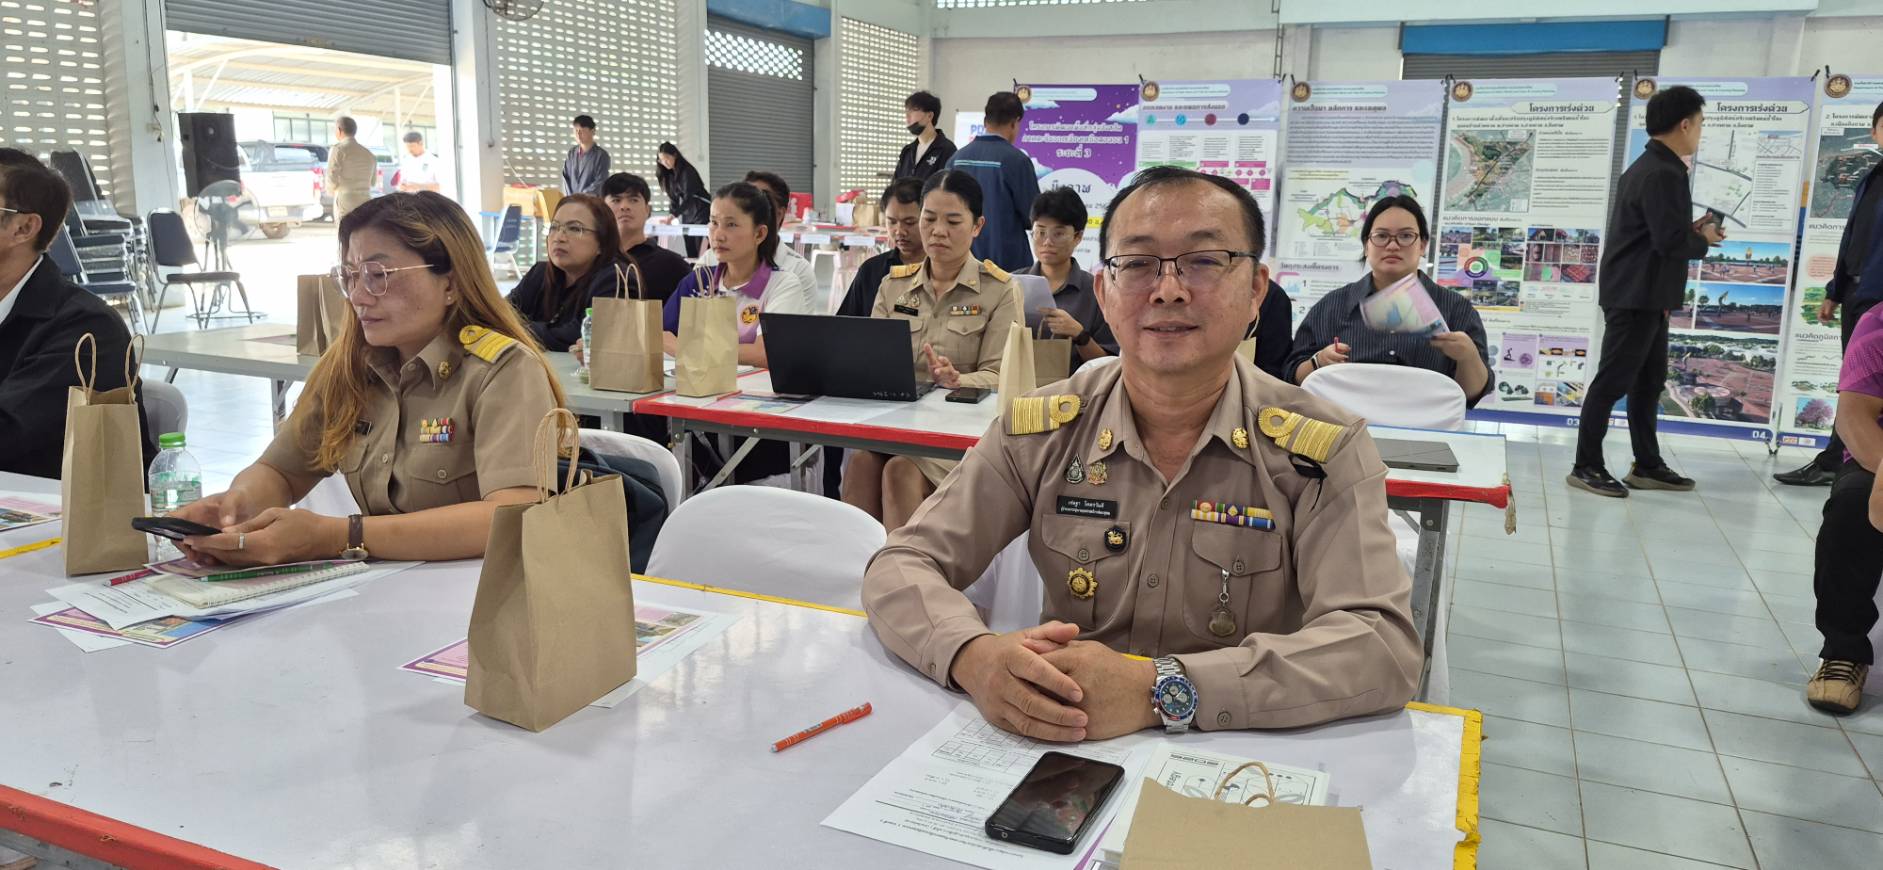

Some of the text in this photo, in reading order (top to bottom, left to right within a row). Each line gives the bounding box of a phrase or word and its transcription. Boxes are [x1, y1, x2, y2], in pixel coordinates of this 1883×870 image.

[1716, 102, 1788, 113] โครงการเร่งด่วน
[1752, 430, 1766, 439] 04
